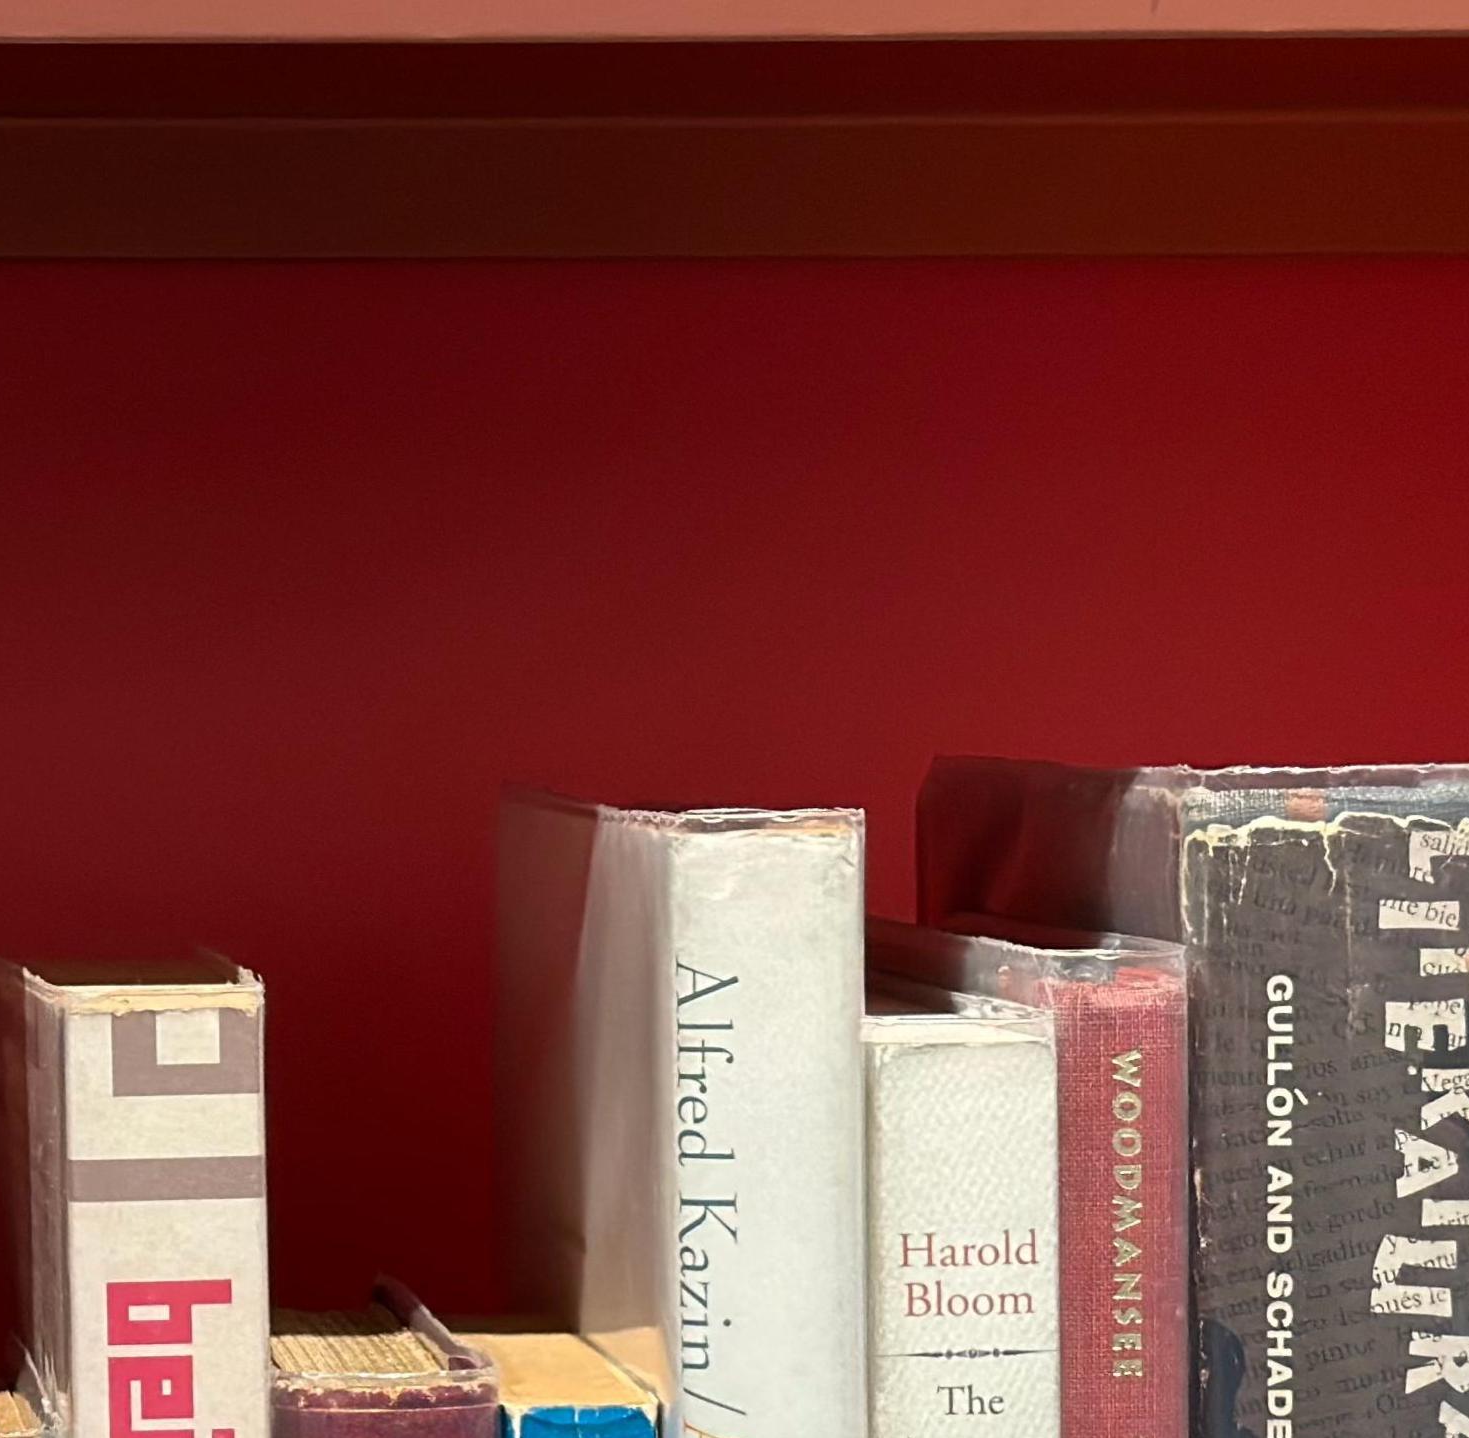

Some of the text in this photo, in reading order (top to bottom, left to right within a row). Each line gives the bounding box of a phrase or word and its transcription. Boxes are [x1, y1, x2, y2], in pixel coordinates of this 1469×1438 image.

[673, 957, 742, 1166] Alfred
[1265, 974, 1308, 1147] GULLÓN
[899, 1229, 1039, 1267] Harold
[1109, 1049, 1145, 1379] WOODMANSEE
[1267, 1165, 1293, 1255] AND
[904, 1281, 1035, 1318] Bloom
[937, 1385, 1004, 1416] The
